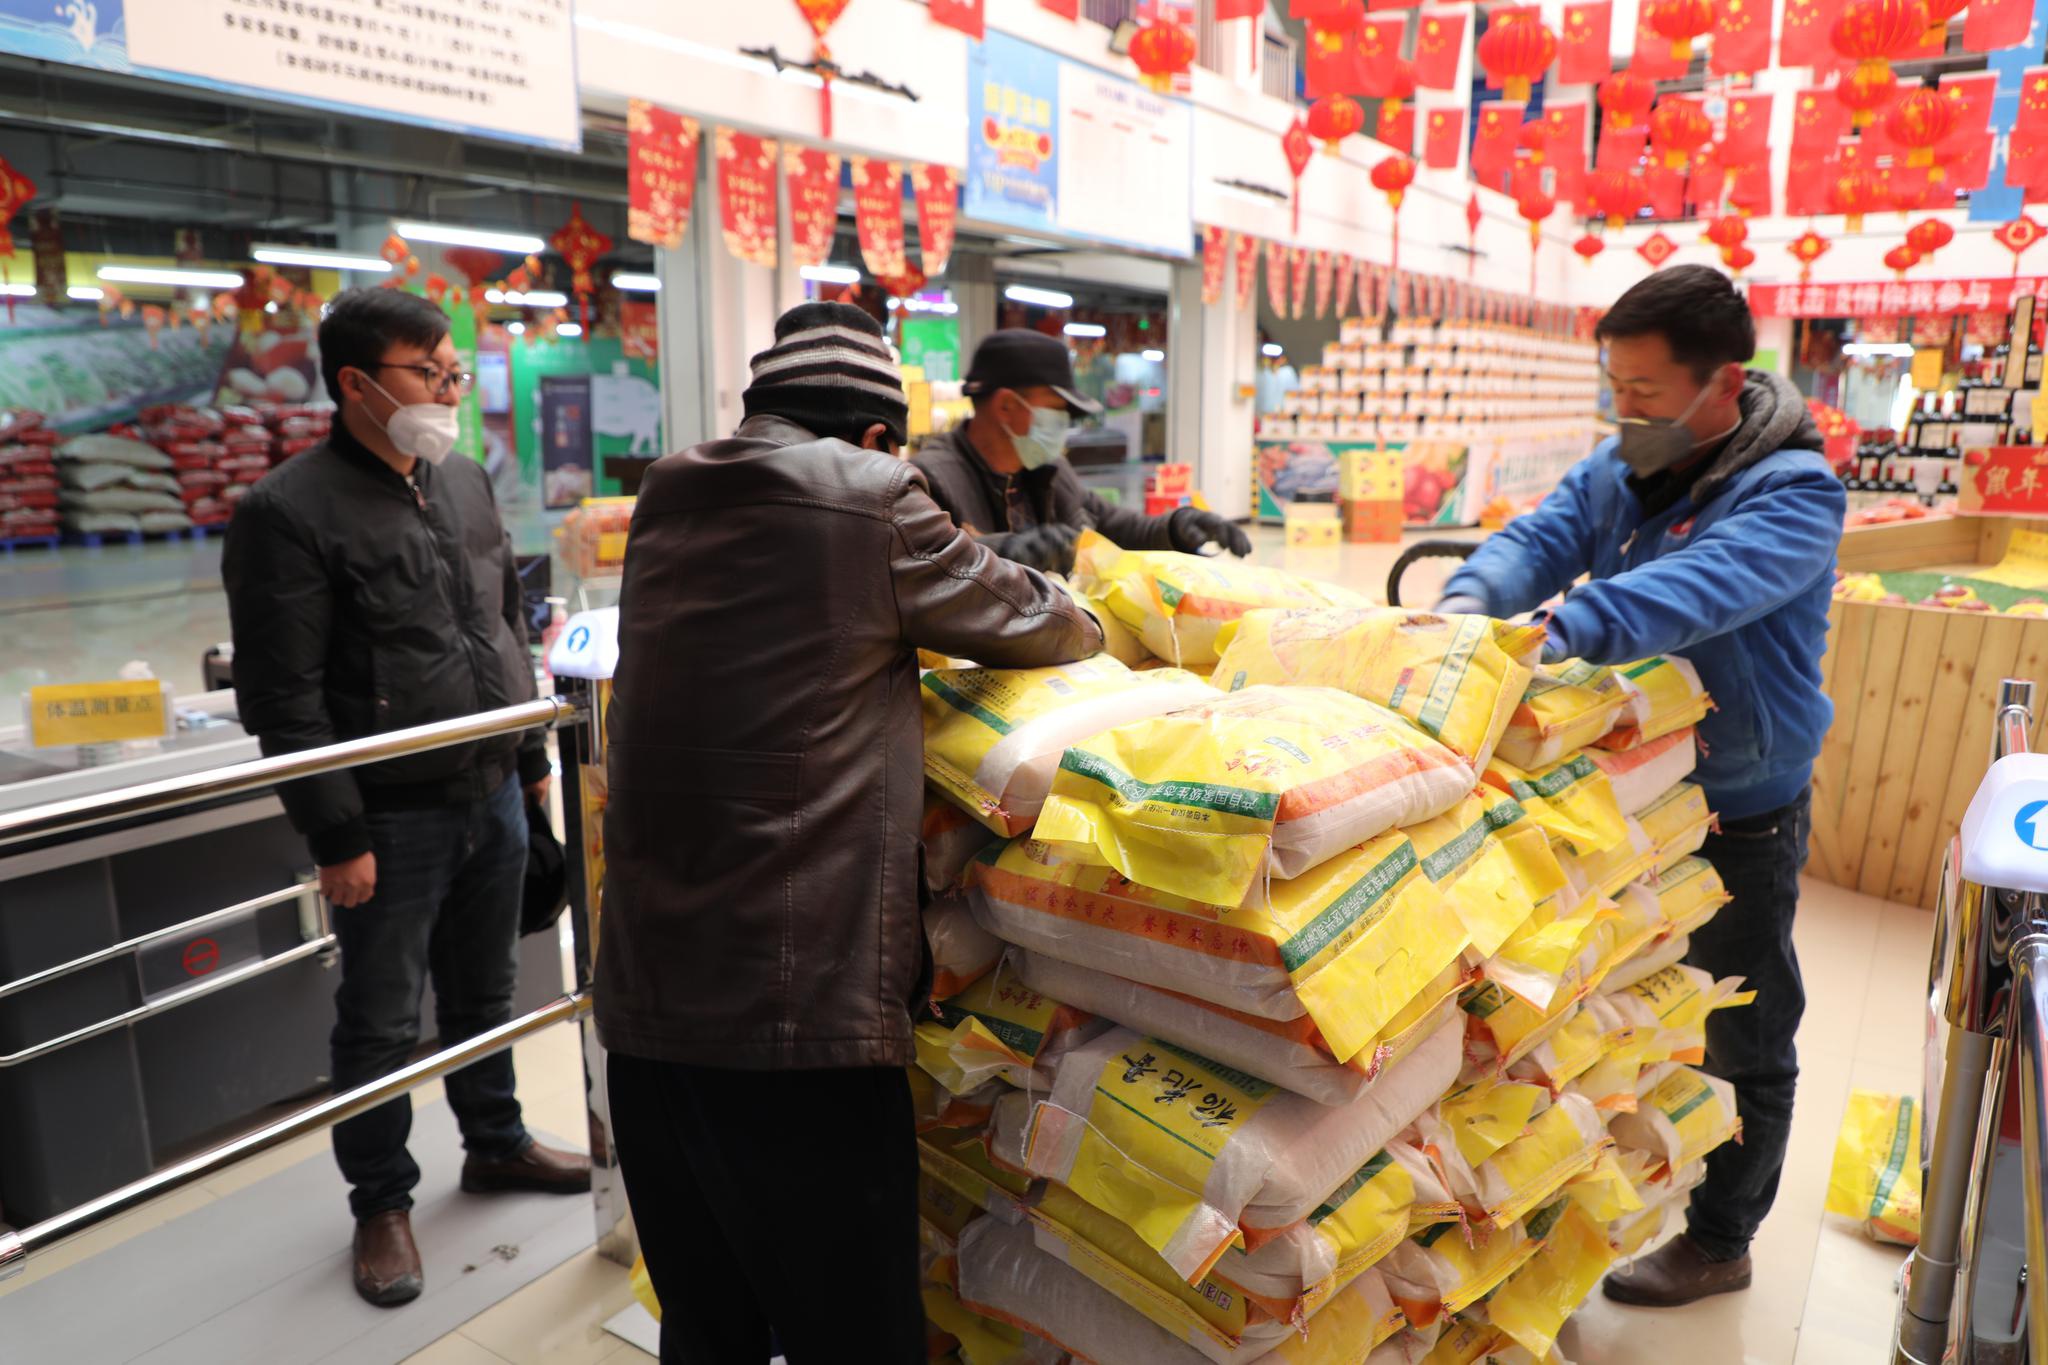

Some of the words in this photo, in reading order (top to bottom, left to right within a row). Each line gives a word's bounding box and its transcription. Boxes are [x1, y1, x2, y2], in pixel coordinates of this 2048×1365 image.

[47, 694, 154, 719] 体温测量点
[1079, 755, 1258, 810] 产自国家级生态示区兴凯湖畔
[1122, 1052, 1238, 1128] 稻花香
